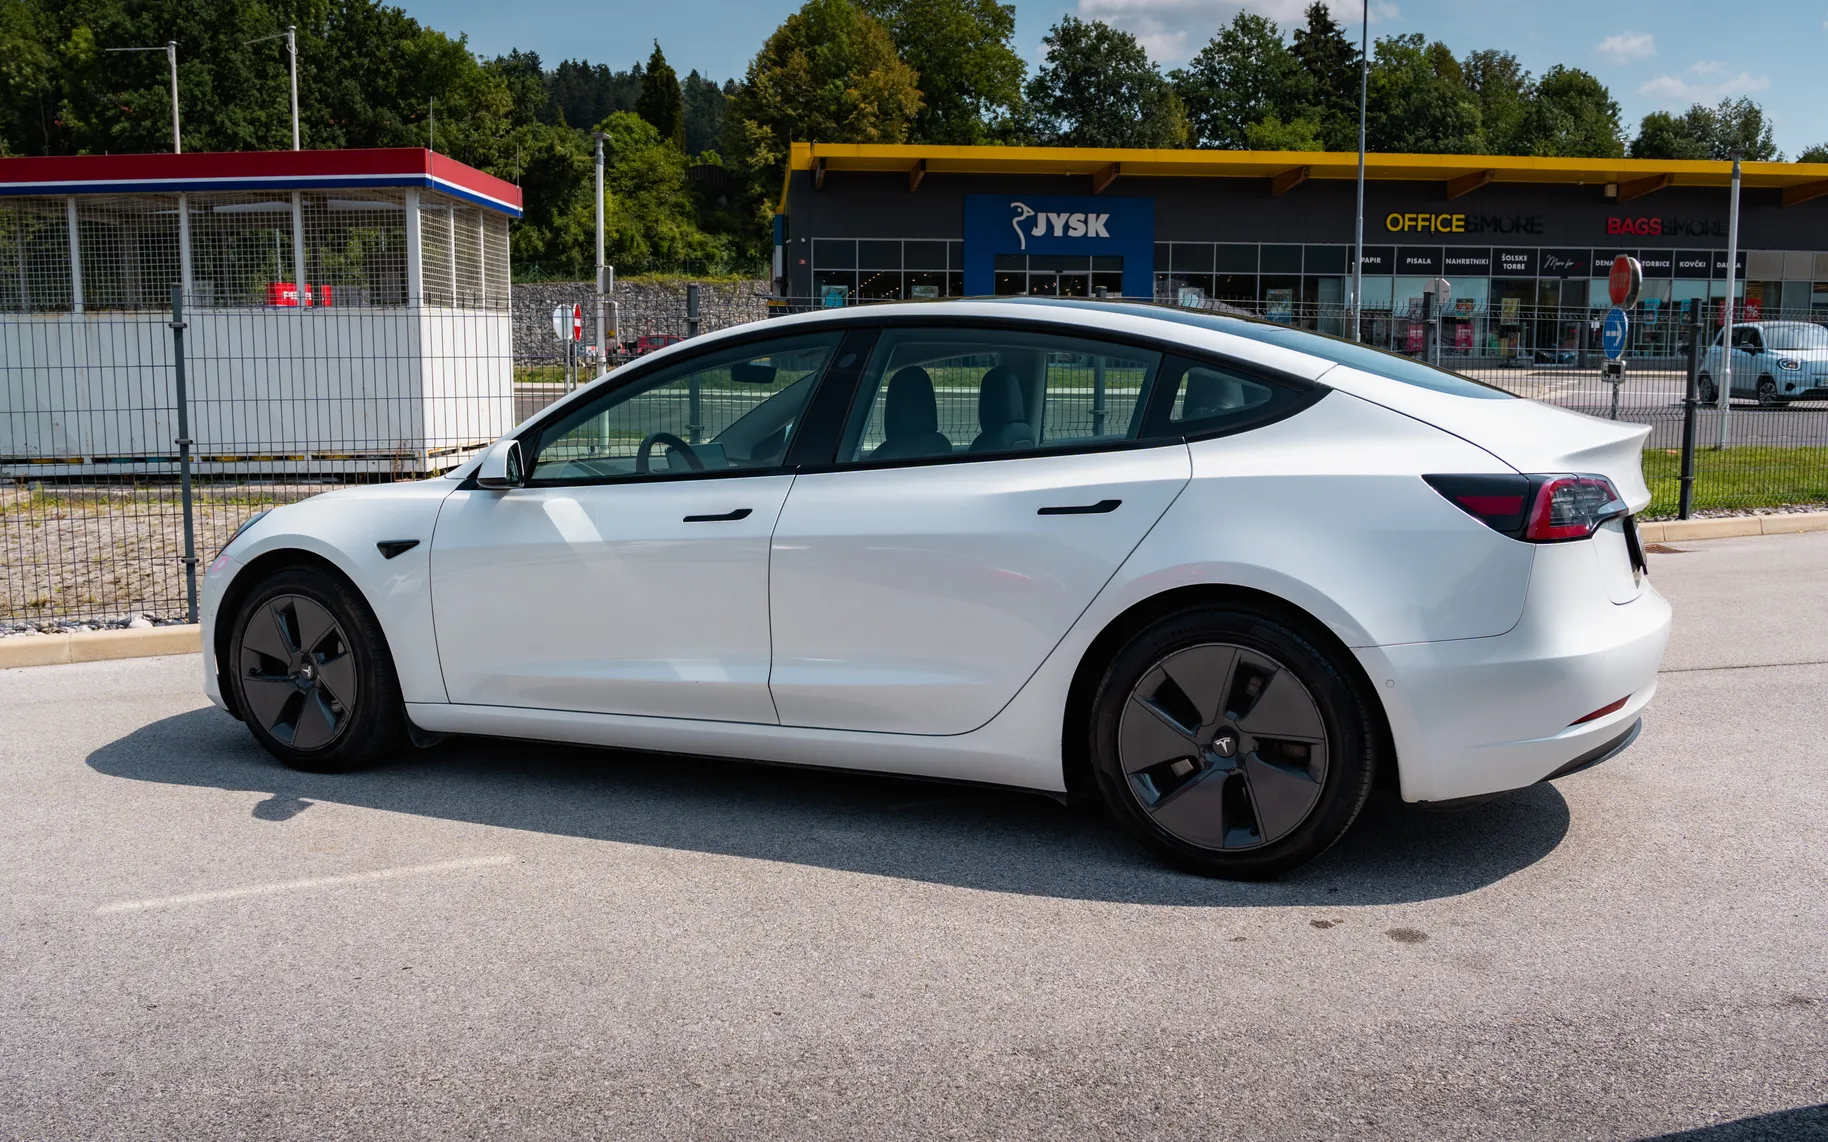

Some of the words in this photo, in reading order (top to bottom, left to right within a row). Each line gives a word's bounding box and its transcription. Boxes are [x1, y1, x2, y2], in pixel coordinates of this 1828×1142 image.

[1030, 212, 1110, 238] JYSK
[1501, 253, 1528, 262] ŠOLSKE
[1679, 259, 1706, 268] KOVČKI
[1611, 272, 1629, 289] STOP
